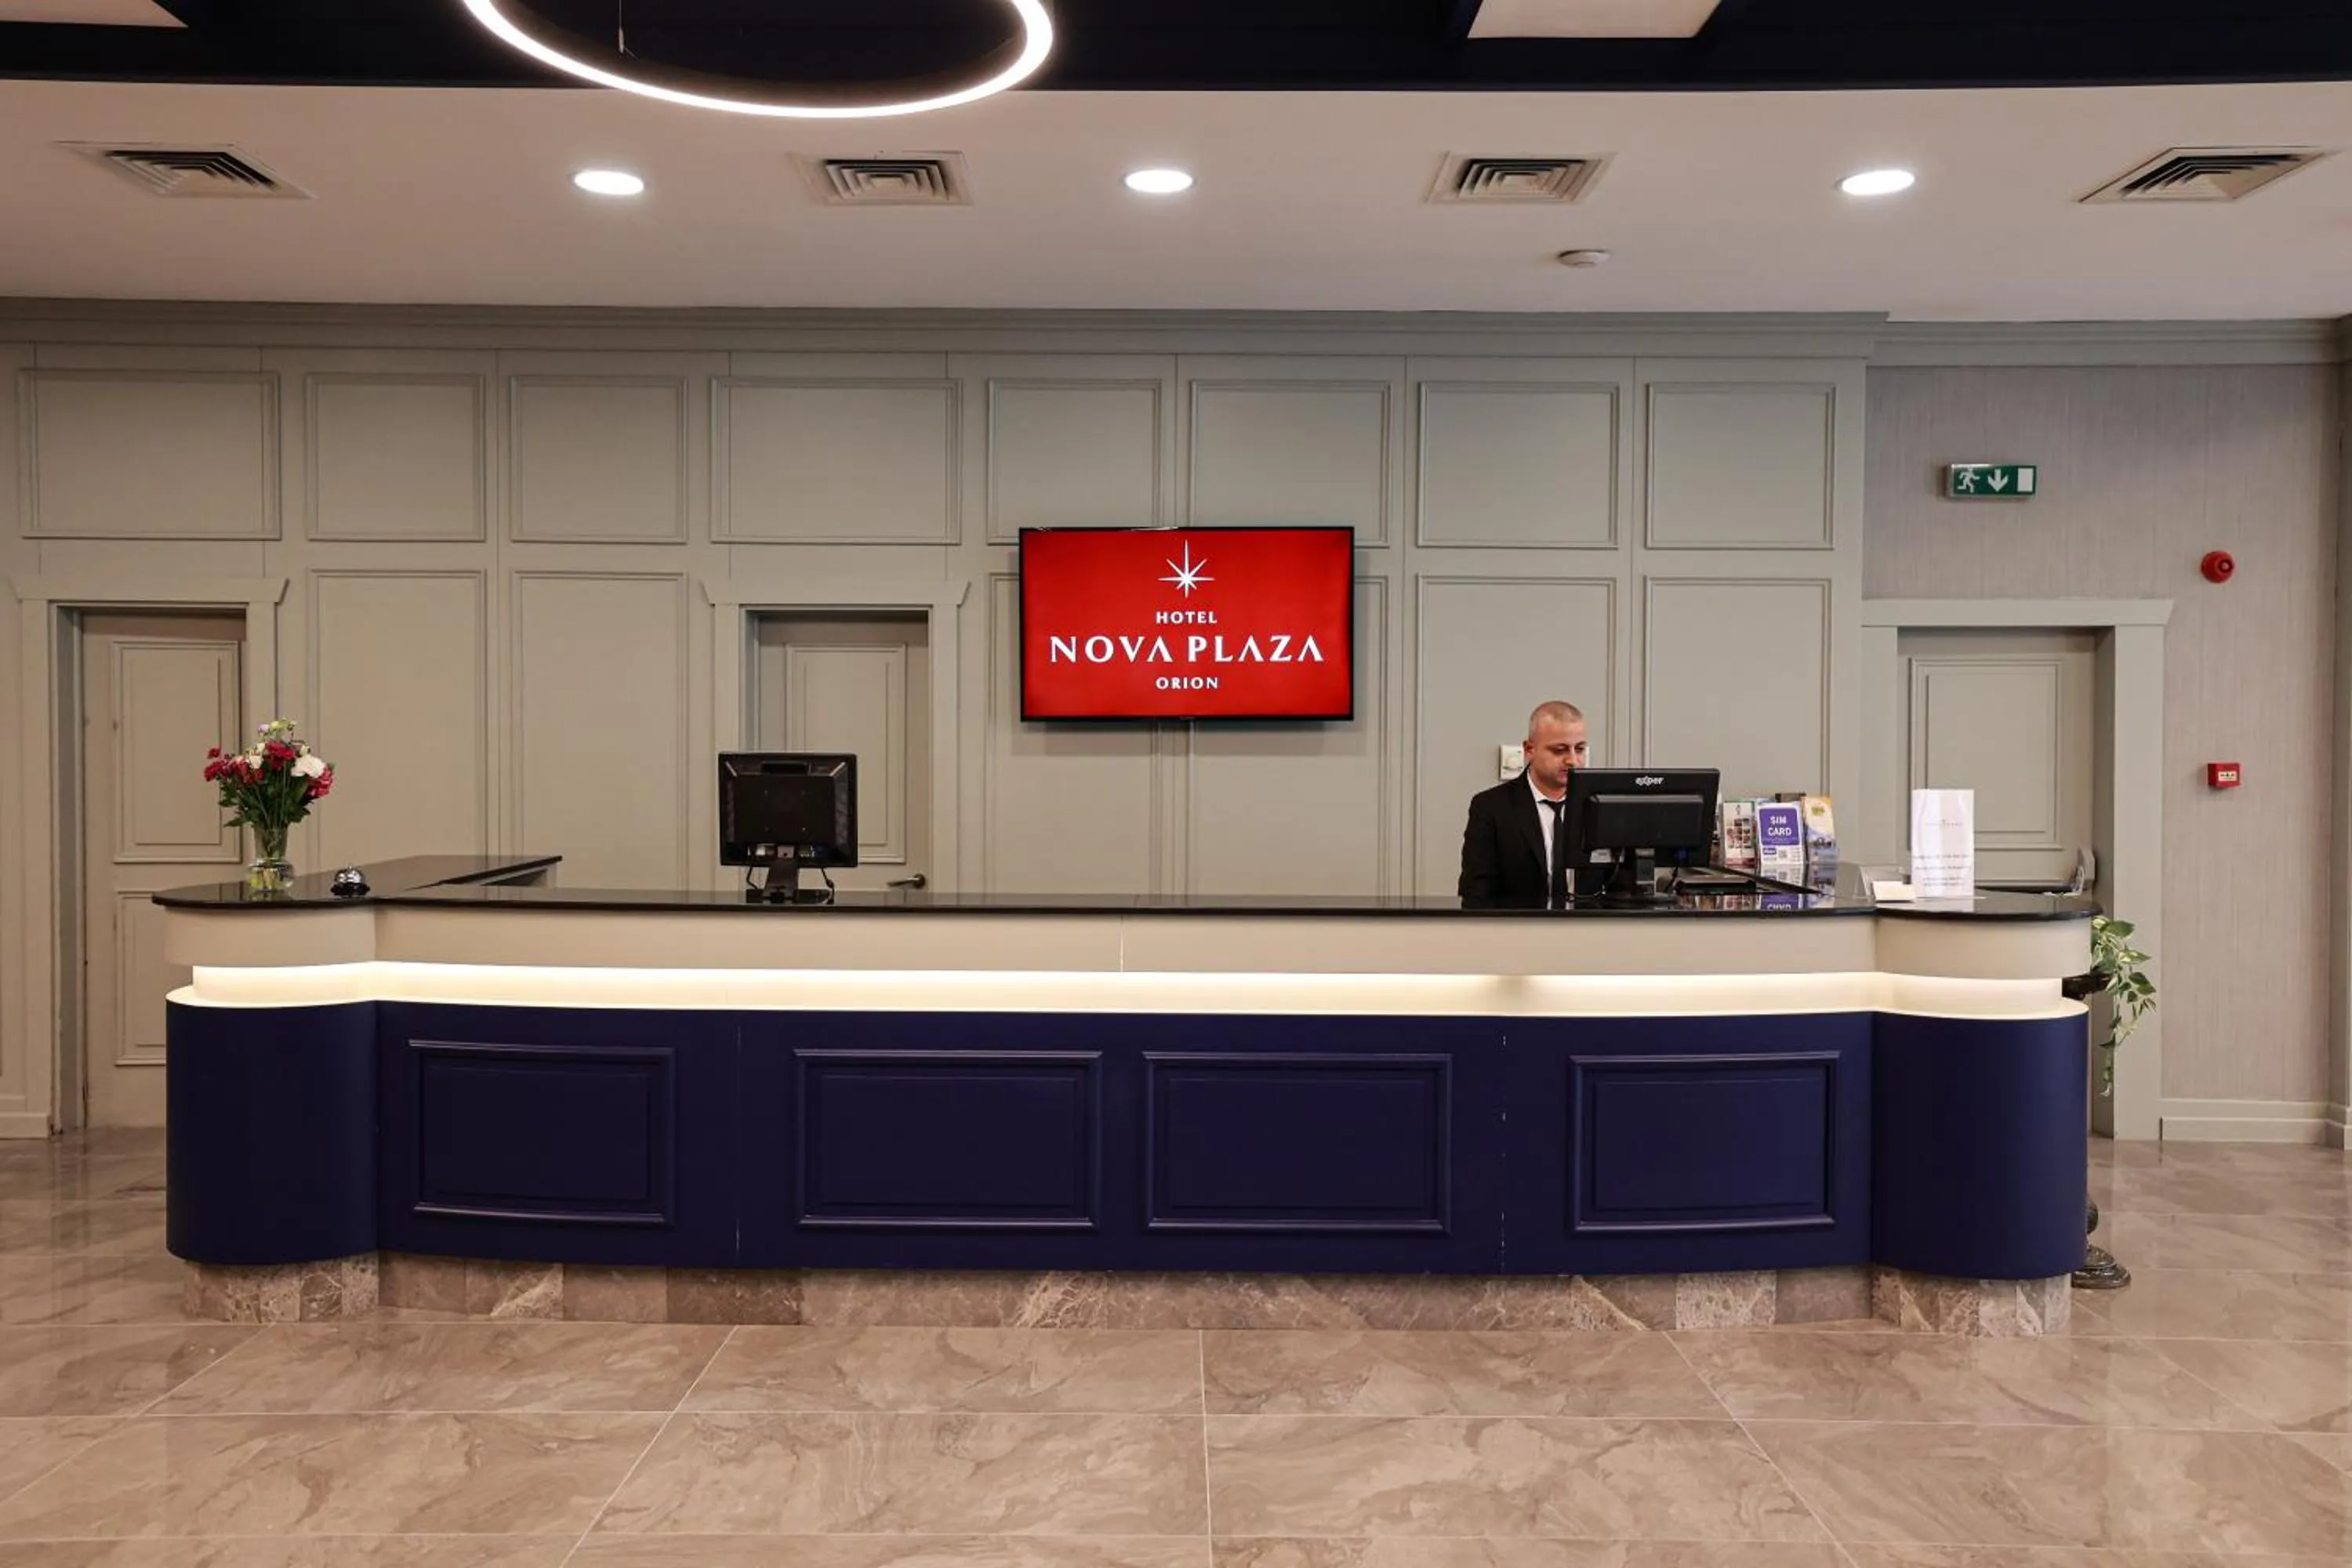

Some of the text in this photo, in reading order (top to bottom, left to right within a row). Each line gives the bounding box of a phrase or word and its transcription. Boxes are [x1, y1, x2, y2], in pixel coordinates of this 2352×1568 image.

[1156, 611, 1218, 624] HOTEL
[1050, 635, 1323, 662] NOVA PLAZA
[1155, 677, 1218, 690] ORION
[1769, 815, 1788, 825] SIM
[1767, 827, 1793, 837] CARD
